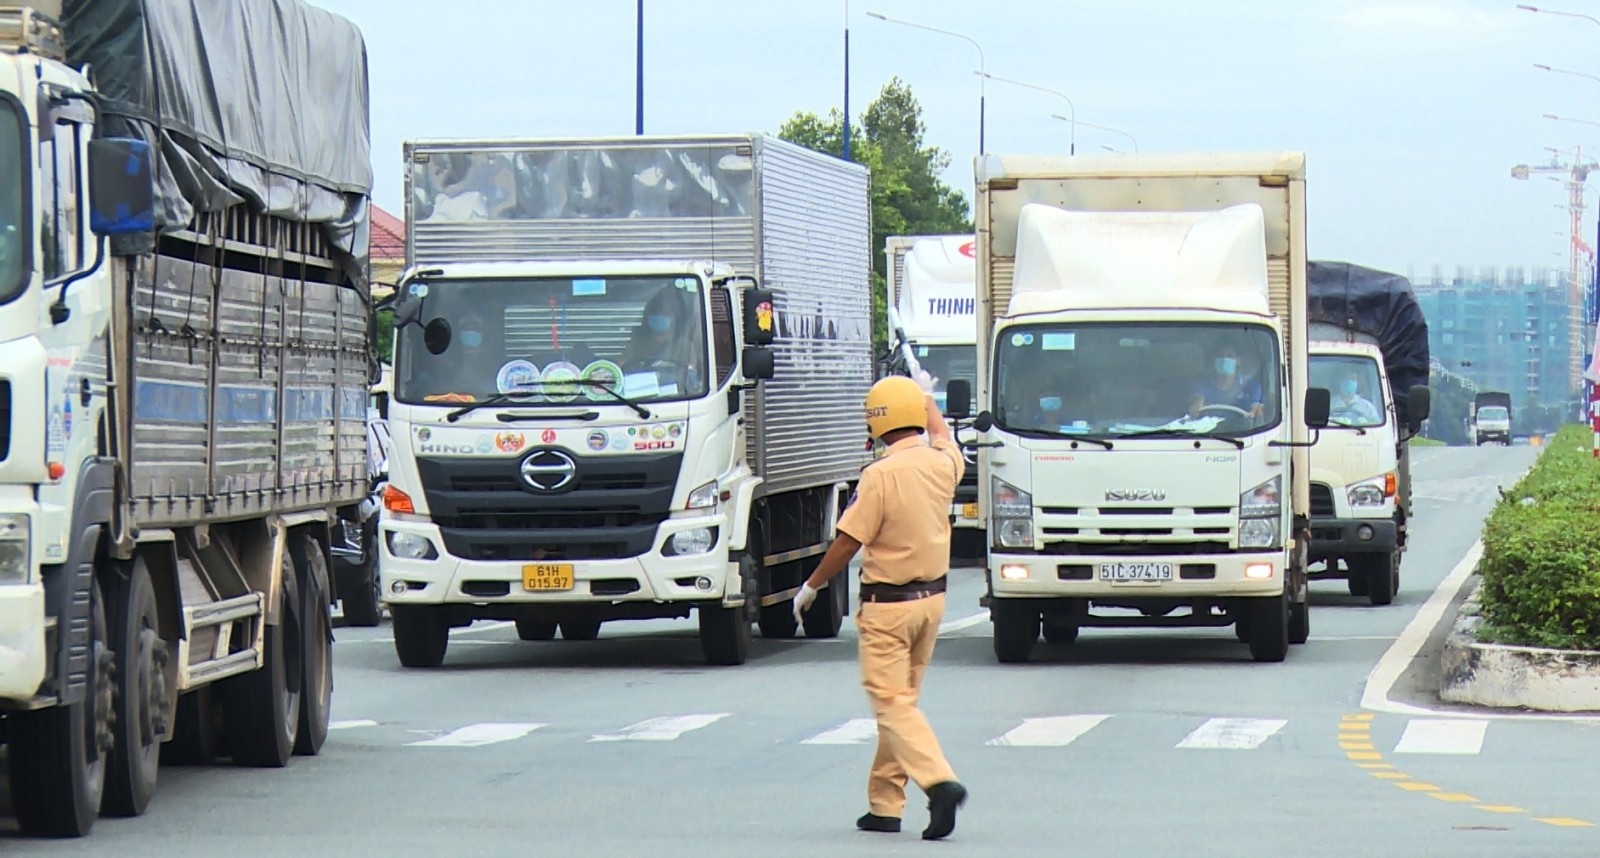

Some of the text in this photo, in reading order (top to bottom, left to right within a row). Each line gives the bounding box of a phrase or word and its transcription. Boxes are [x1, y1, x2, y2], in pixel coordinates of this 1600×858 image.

[928, 298, 975, 318] THỊNH
[420, 444, 474, 454] HINO
[634, 440, 675, 450] 500
[1105, 488, 1166, 501] ISUZU
[537, 566, 559, 577] 61H
